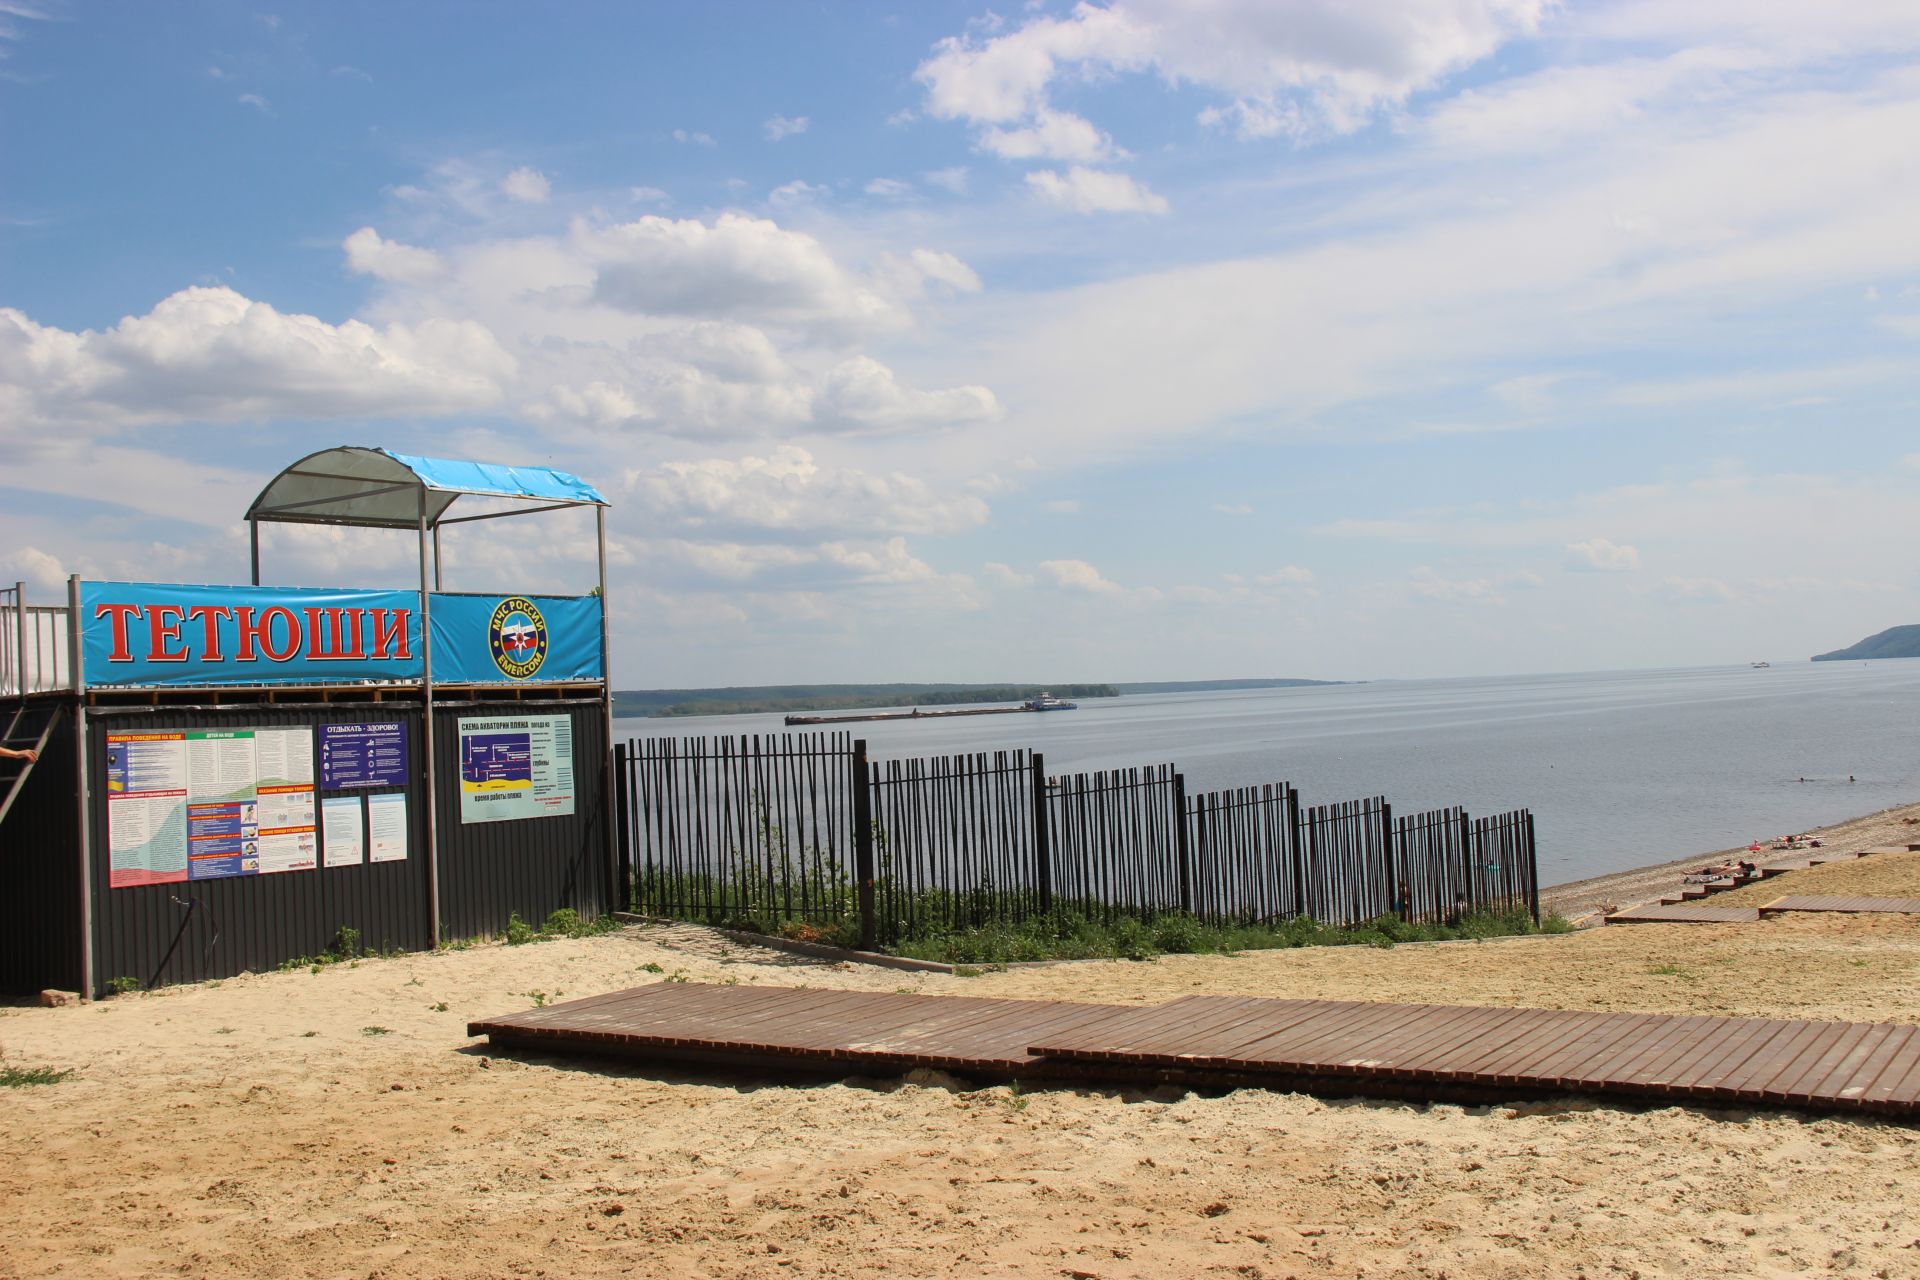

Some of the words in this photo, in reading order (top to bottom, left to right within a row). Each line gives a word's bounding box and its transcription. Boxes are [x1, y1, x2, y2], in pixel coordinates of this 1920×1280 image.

[492, 604, 509, 631] МЧС
[509, 600, 545, 632] РОССИИ
[95, 603, 412, 662] ТЕТЮШИ
[497, 651, 543, 676] EMERCOM
[327, 725, 362, 733] ОТДЫХАТЬ
[366, 723, 399, 732] ЗДОРОВО!
